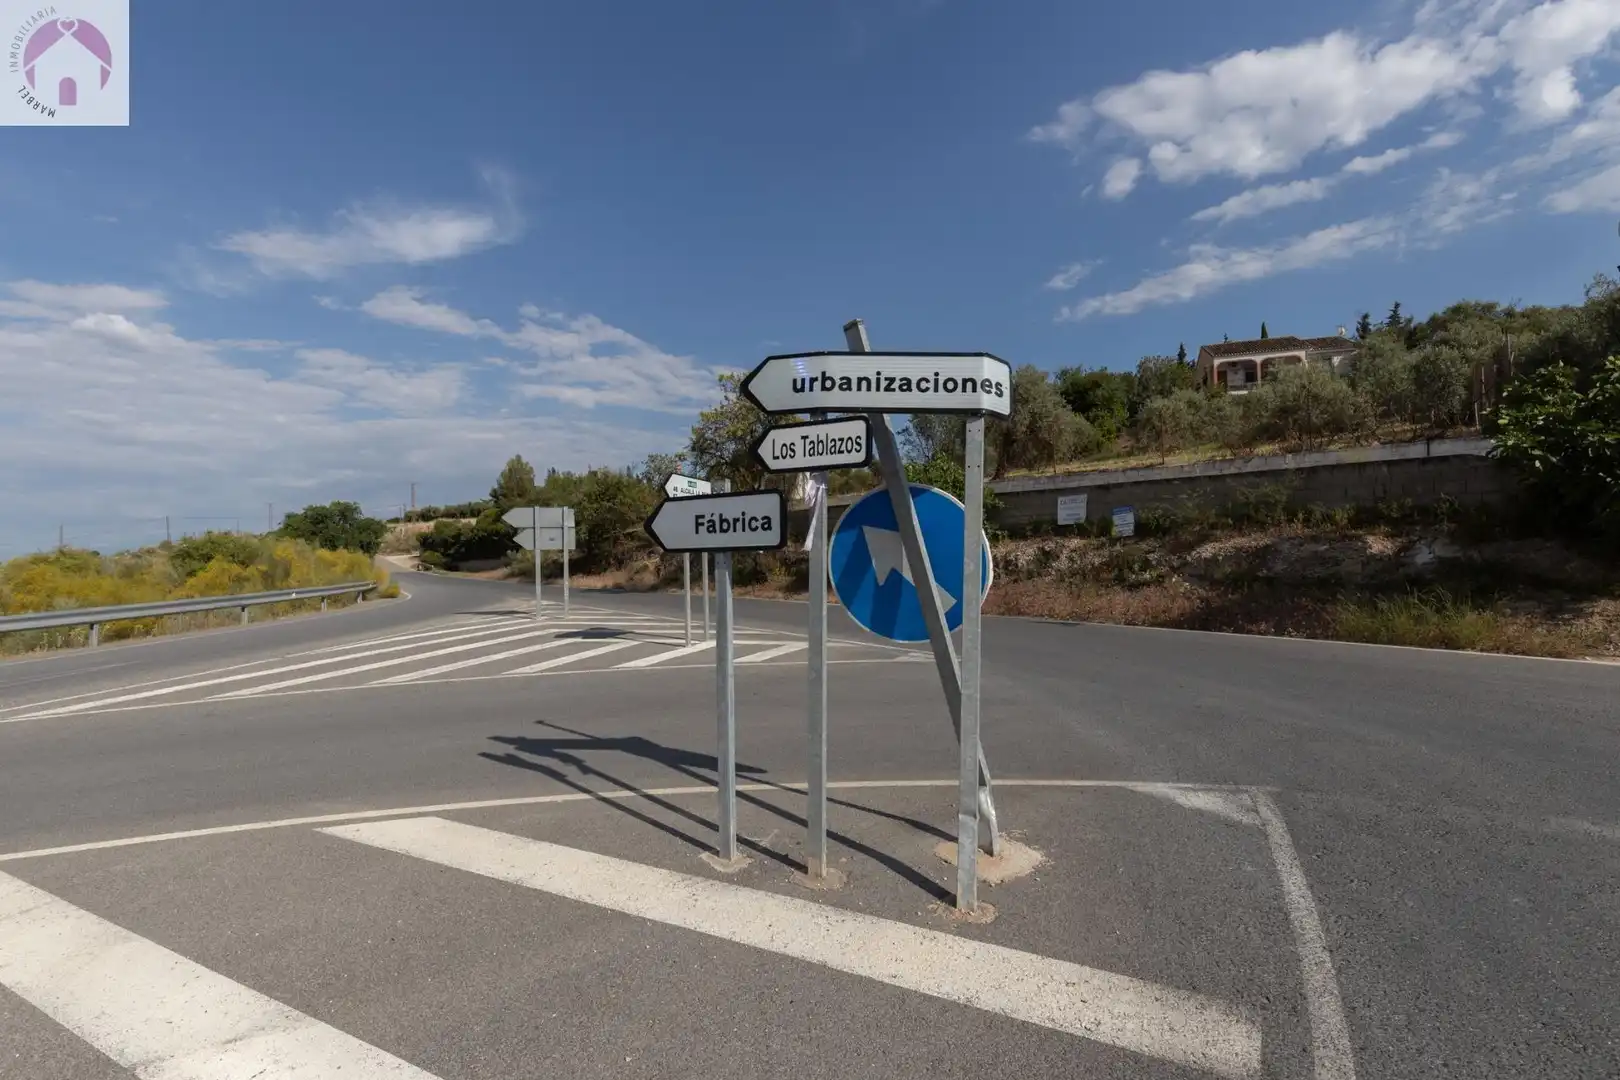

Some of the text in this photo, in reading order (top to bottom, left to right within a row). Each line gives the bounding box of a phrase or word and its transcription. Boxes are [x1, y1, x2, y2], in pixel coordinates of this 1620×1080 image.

[792, 370, 1004, 398] urbanizaciones
[772, 433, 863, 460] Los Tablazos
[694, 511, 773, 535] Fábrica
